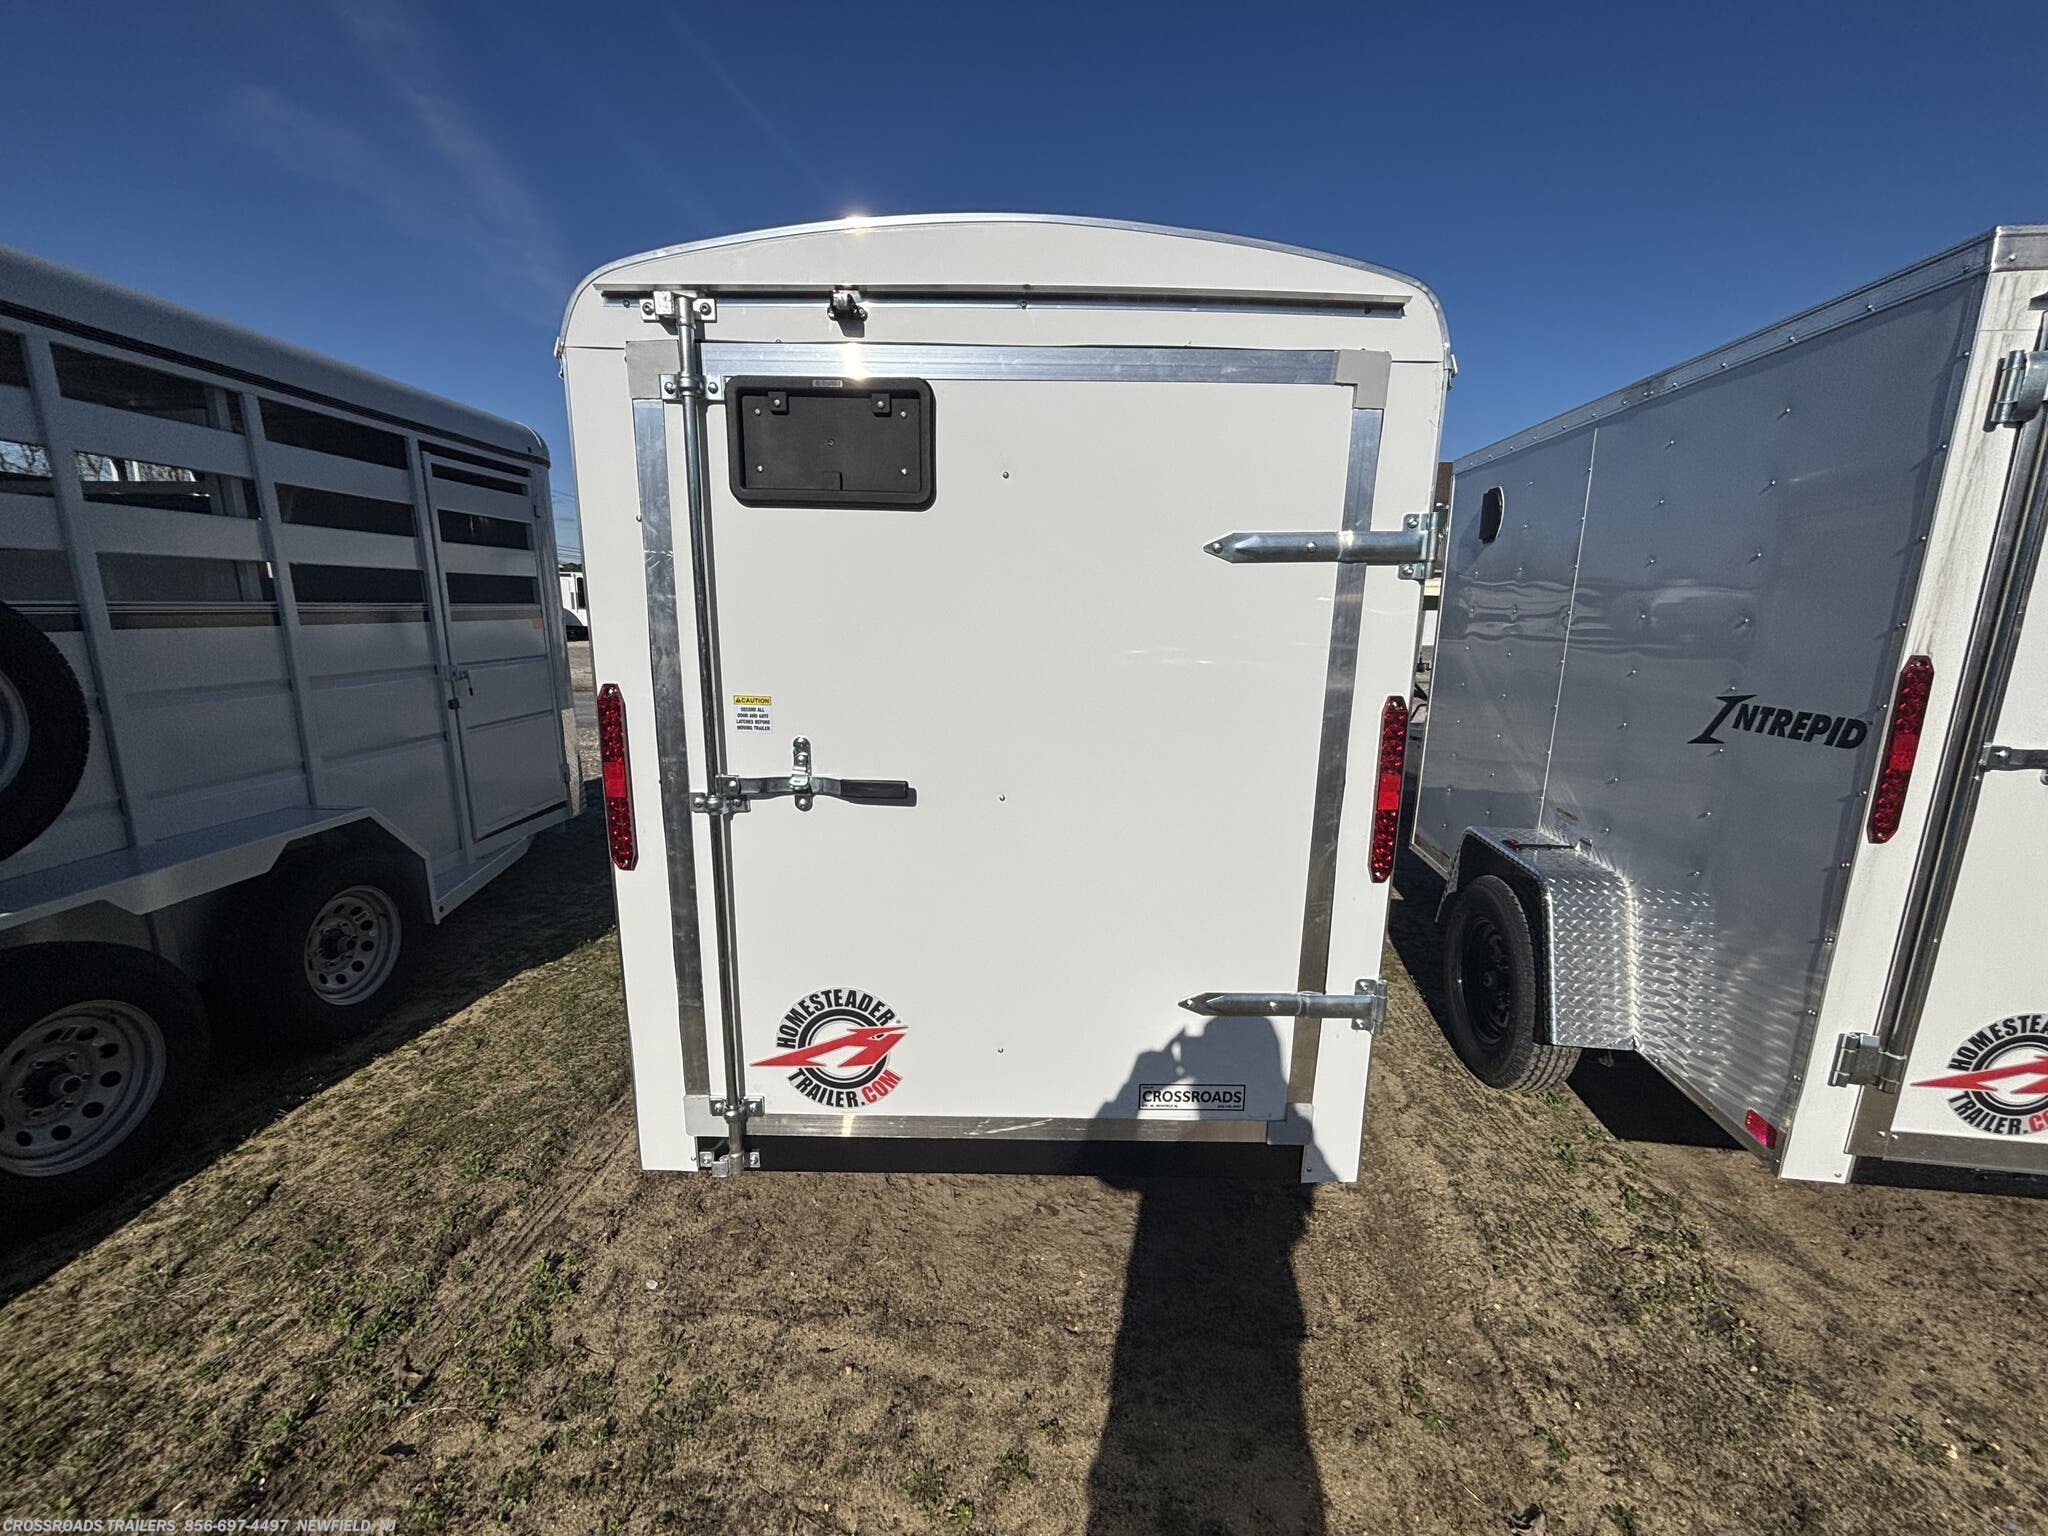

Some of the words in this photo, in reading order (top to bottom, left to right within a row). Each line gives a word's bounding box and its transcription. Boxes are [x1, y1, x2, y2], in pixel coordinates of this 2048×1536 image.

[1687, 695, 1868, 749] INTREPID
[776, 988, 896, 1050] HOMESTEADER
[787, 1068, 902, 1109] TRAILER.COM
[1142, 1090, 1243, 1104] CROSSROADS
